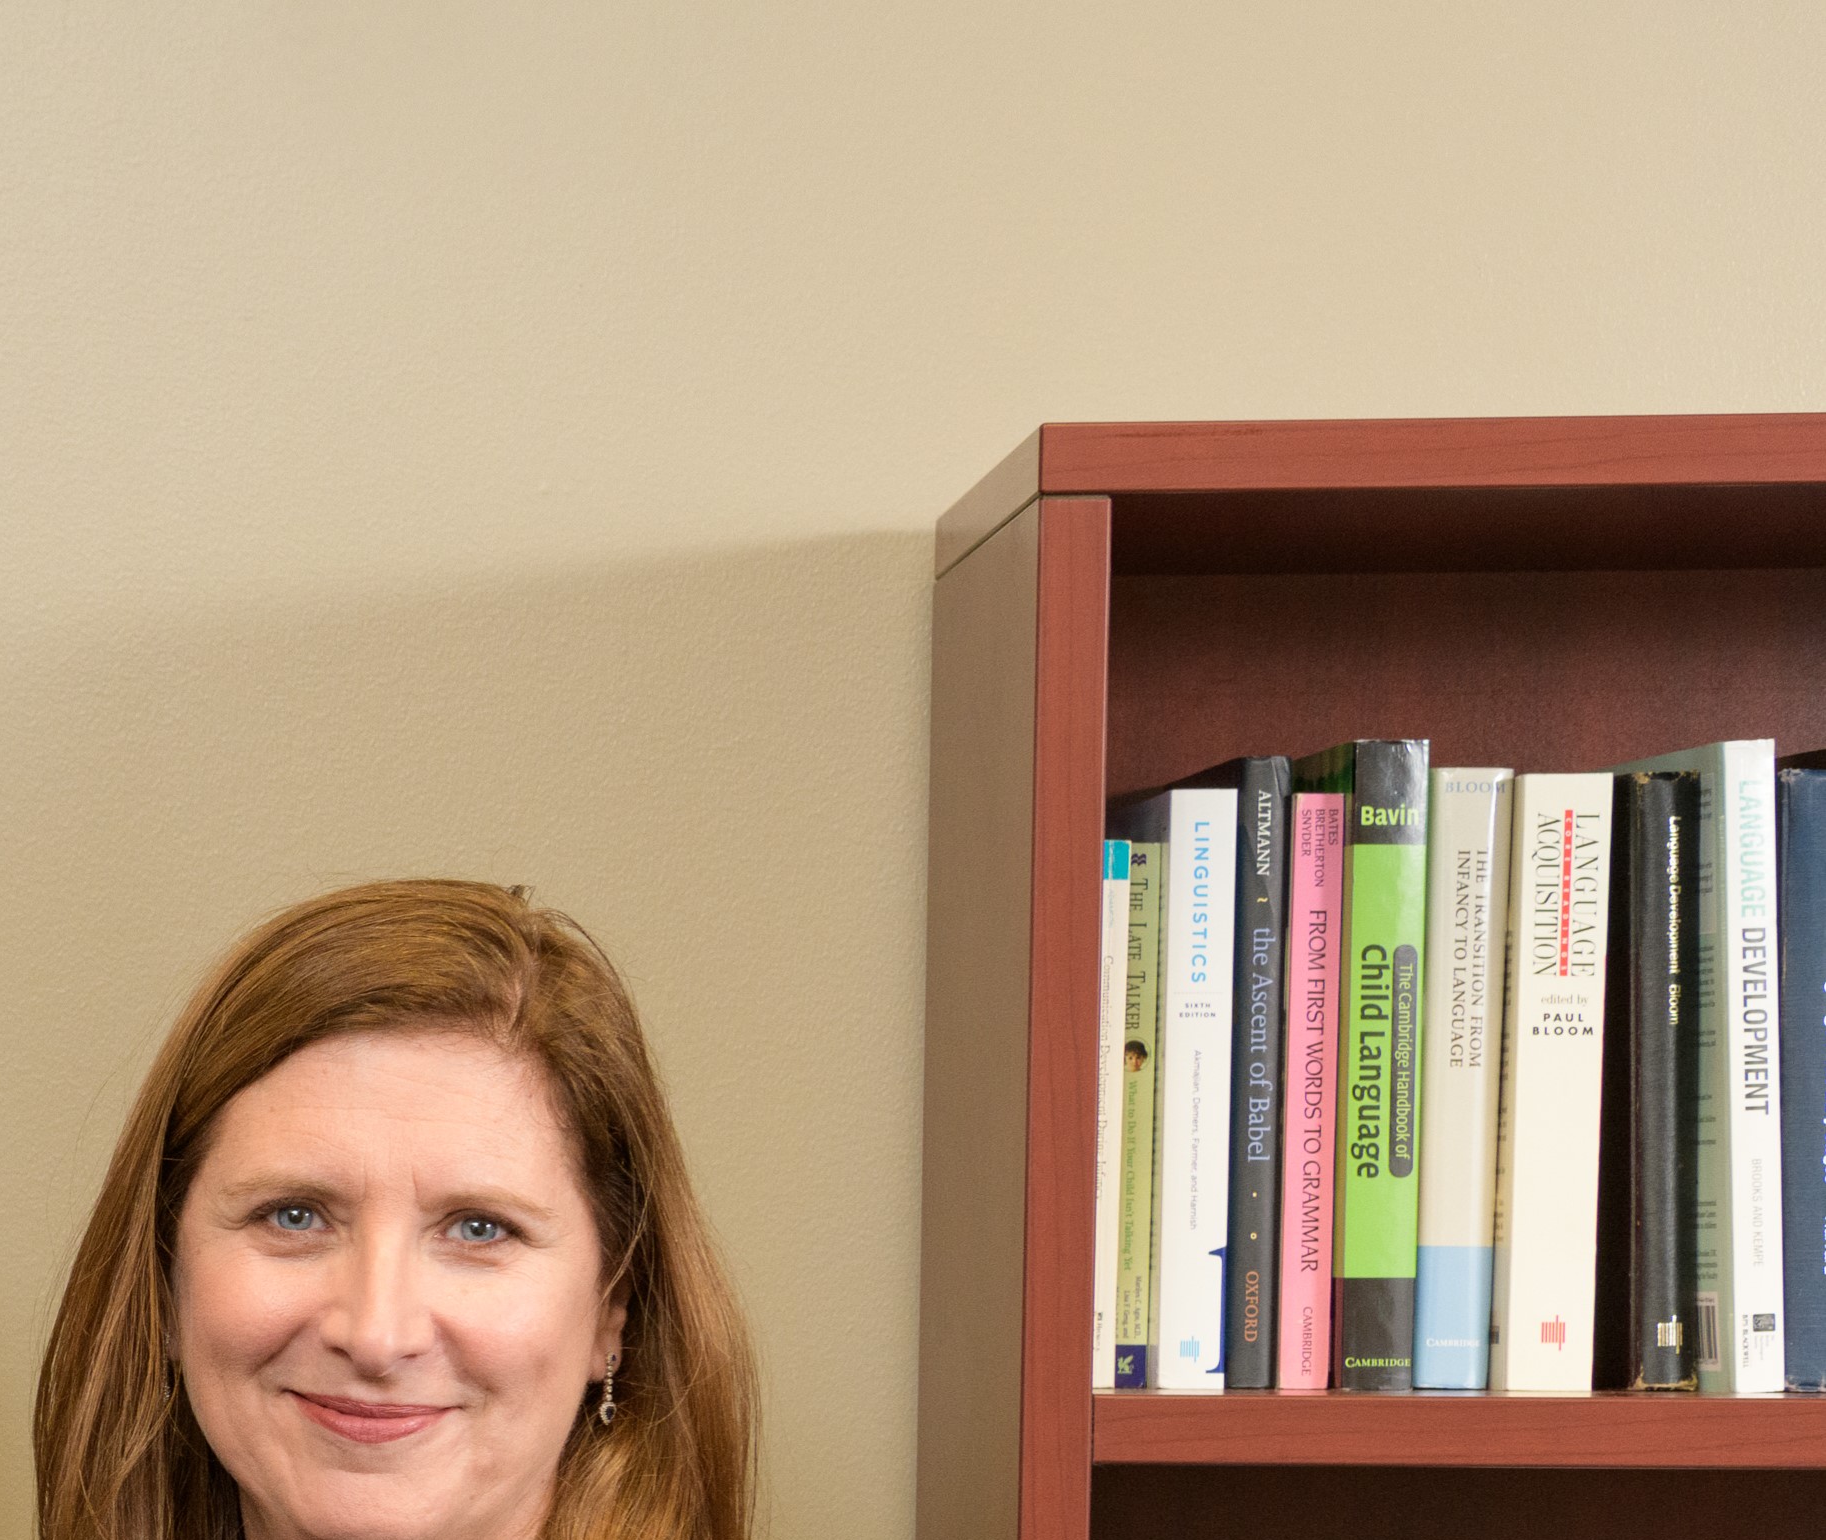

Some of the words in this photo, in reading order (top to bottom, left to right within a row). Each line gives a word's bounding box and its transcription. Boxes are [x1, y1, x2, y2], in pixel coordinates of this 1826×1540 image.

[1360, 804, 1420, 827] Bavin
[1445, 780, 1506, 794] BLOOM
[1257, 790, 1272, 876] ALTMANN
[1301, 809, 1312, 856] SNYDER
[1313, 807, 1326, 890] BRETHERTON
[1328, 809, 1339, 846] BATES
[1563, 817, 1573, 862] CORE
[1667, 815, 1680, 883] Language
[1739, 780, 1767, 919] LANGUAGE
[1128, 878, 1149, 913] THE
[1455, 850, 1471, 930] INFANCY
[1476, 849, 1491, 884] THE
[1532, 812, 1561, 977] ACQUISITION
[1571, 813, 1600, 977] LANGUAGE
[1191, 821, 1210, 983] LINGUISTICS
[1559, 875, 1572, 972] READINGS
[1666, 884, 1680, 974] Development
[1127, 923, 1147, 962] LATE
[1253, 928, 1277, 965] the
[1308, 910, 1327, 970] FROM
[1454, 936, 1468, 960] TO
[1471, 890, 1489, 1006] TRANSITION
[1125, 970, 1146, 1031] TALKER
[1360, 944, 1390, 1020] Child
[1399, 963, 1414, 989] The
[1541, 993, 1573, 1005] edited
[1577, 993, 1589, 1006] by
[1668, 983, 1681, 1025] Bloom
[1178, 1011, 1217, 1019] EDITION
[1250, 968, 1275, 1053] Ascent
[1306, 978, 1326, 1036] FIRST
[1395, 992, 1413, 1068] Cambridge
[1450, 967, 1466, 1067] LANGUAGE
[1532, 1026, 1594, 1036] BLOOM
[1543, 1013, 1585, 1023] PAUL
[1741, 927, 1769, 1115] DEVELOPMENT
[1469, 1016, 1482, 1067] FROM
[1250, 1062, 1273, 1091] of
[1304, 1040, 1324, 1119] WORDS
[1350, 1031, 1385, 1178] Language
[1394, 1071, 1411, 1142] Handbook
[1248, 1096, 1271, 1162] Babel
[1303, 1124, 1322, 1154] TO
[1395, 1144, 1411, 1160] of
[1301, 1160, 1321, 1272] GRAMMAR
[1245, 1271, 1259, 1342] OXFORD
[1301, 1306, 1313, 1375] CAMBRIDGE
[1344, 1356, 1412, 1369] CAMBRIDGE
